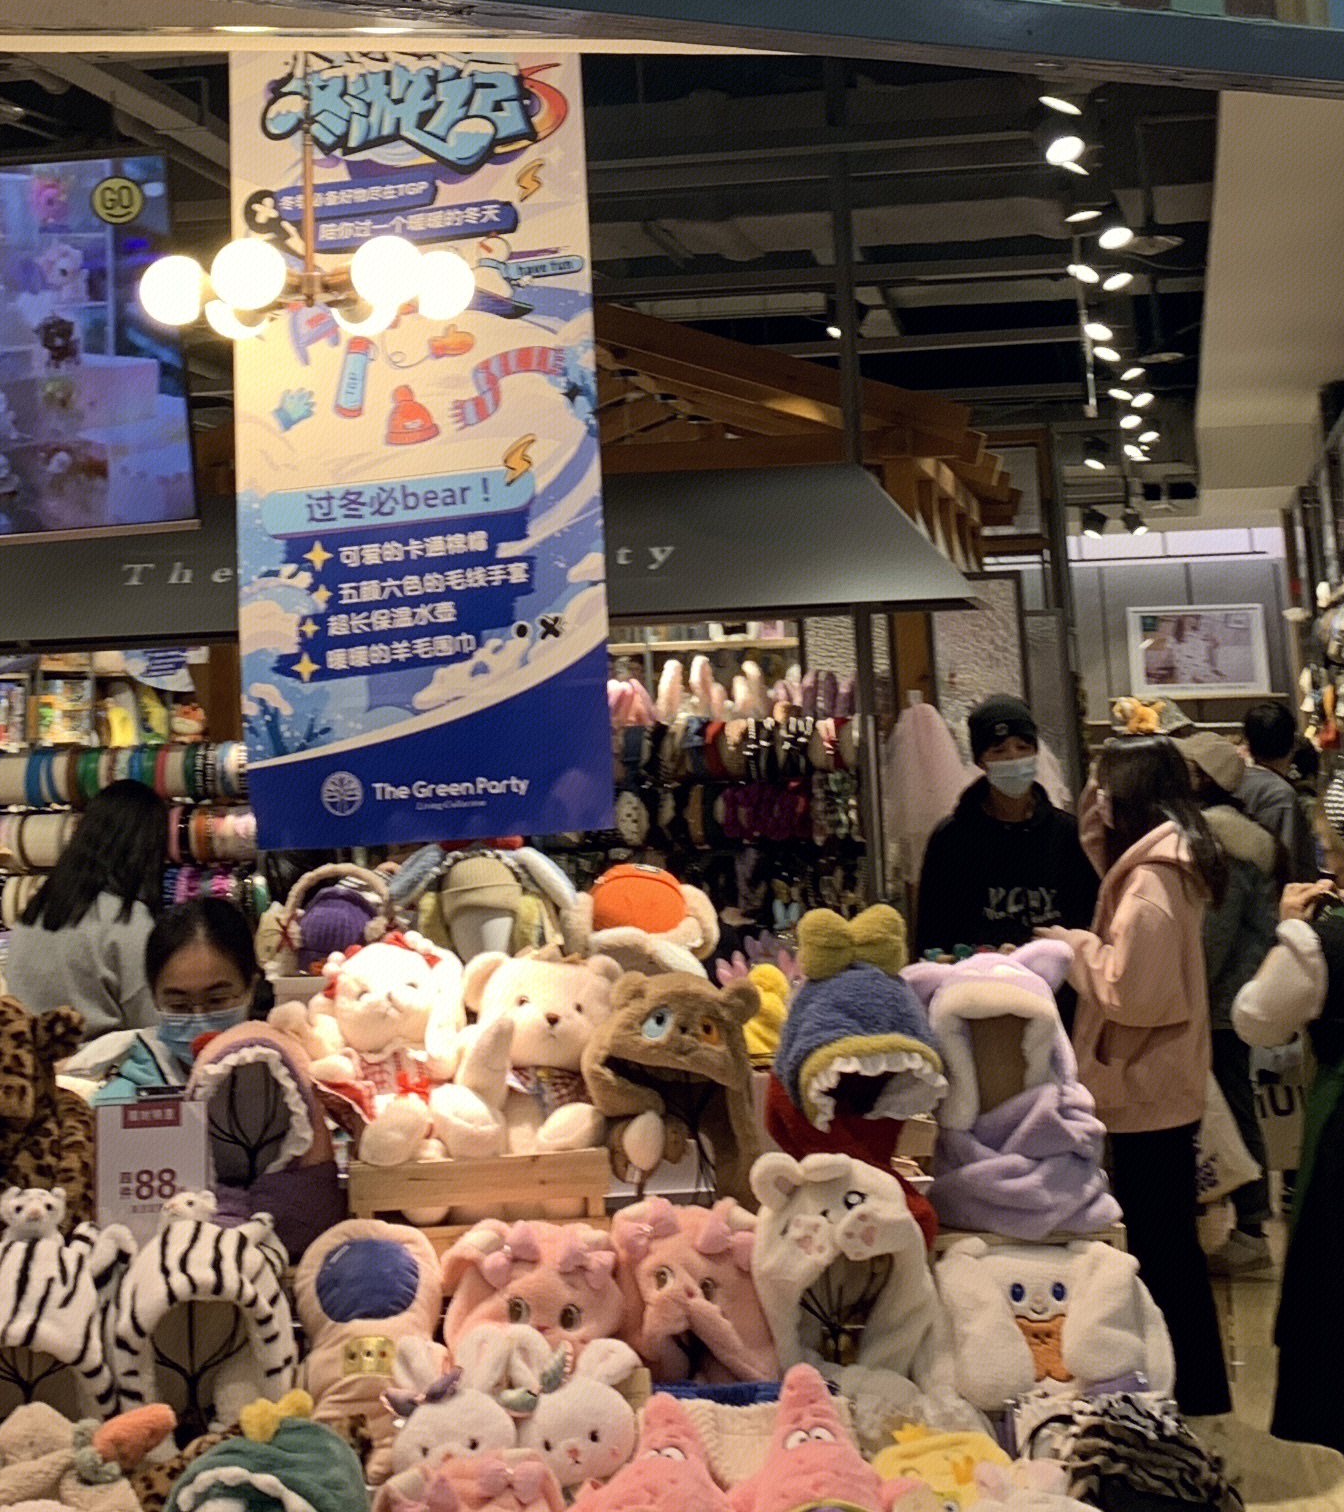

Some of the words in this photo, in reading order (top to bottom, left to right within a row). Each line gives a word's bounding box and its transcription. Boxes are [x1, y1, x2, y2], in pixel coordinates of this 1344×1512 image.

[337, 561, 531, 605] 五颜六色的毛线手套
[371, 782, 411, 801] The
[412, 780, 475, 799] Green
[475, 776, 530, 796] Party
[136, 1168, 176, 1200] 88
